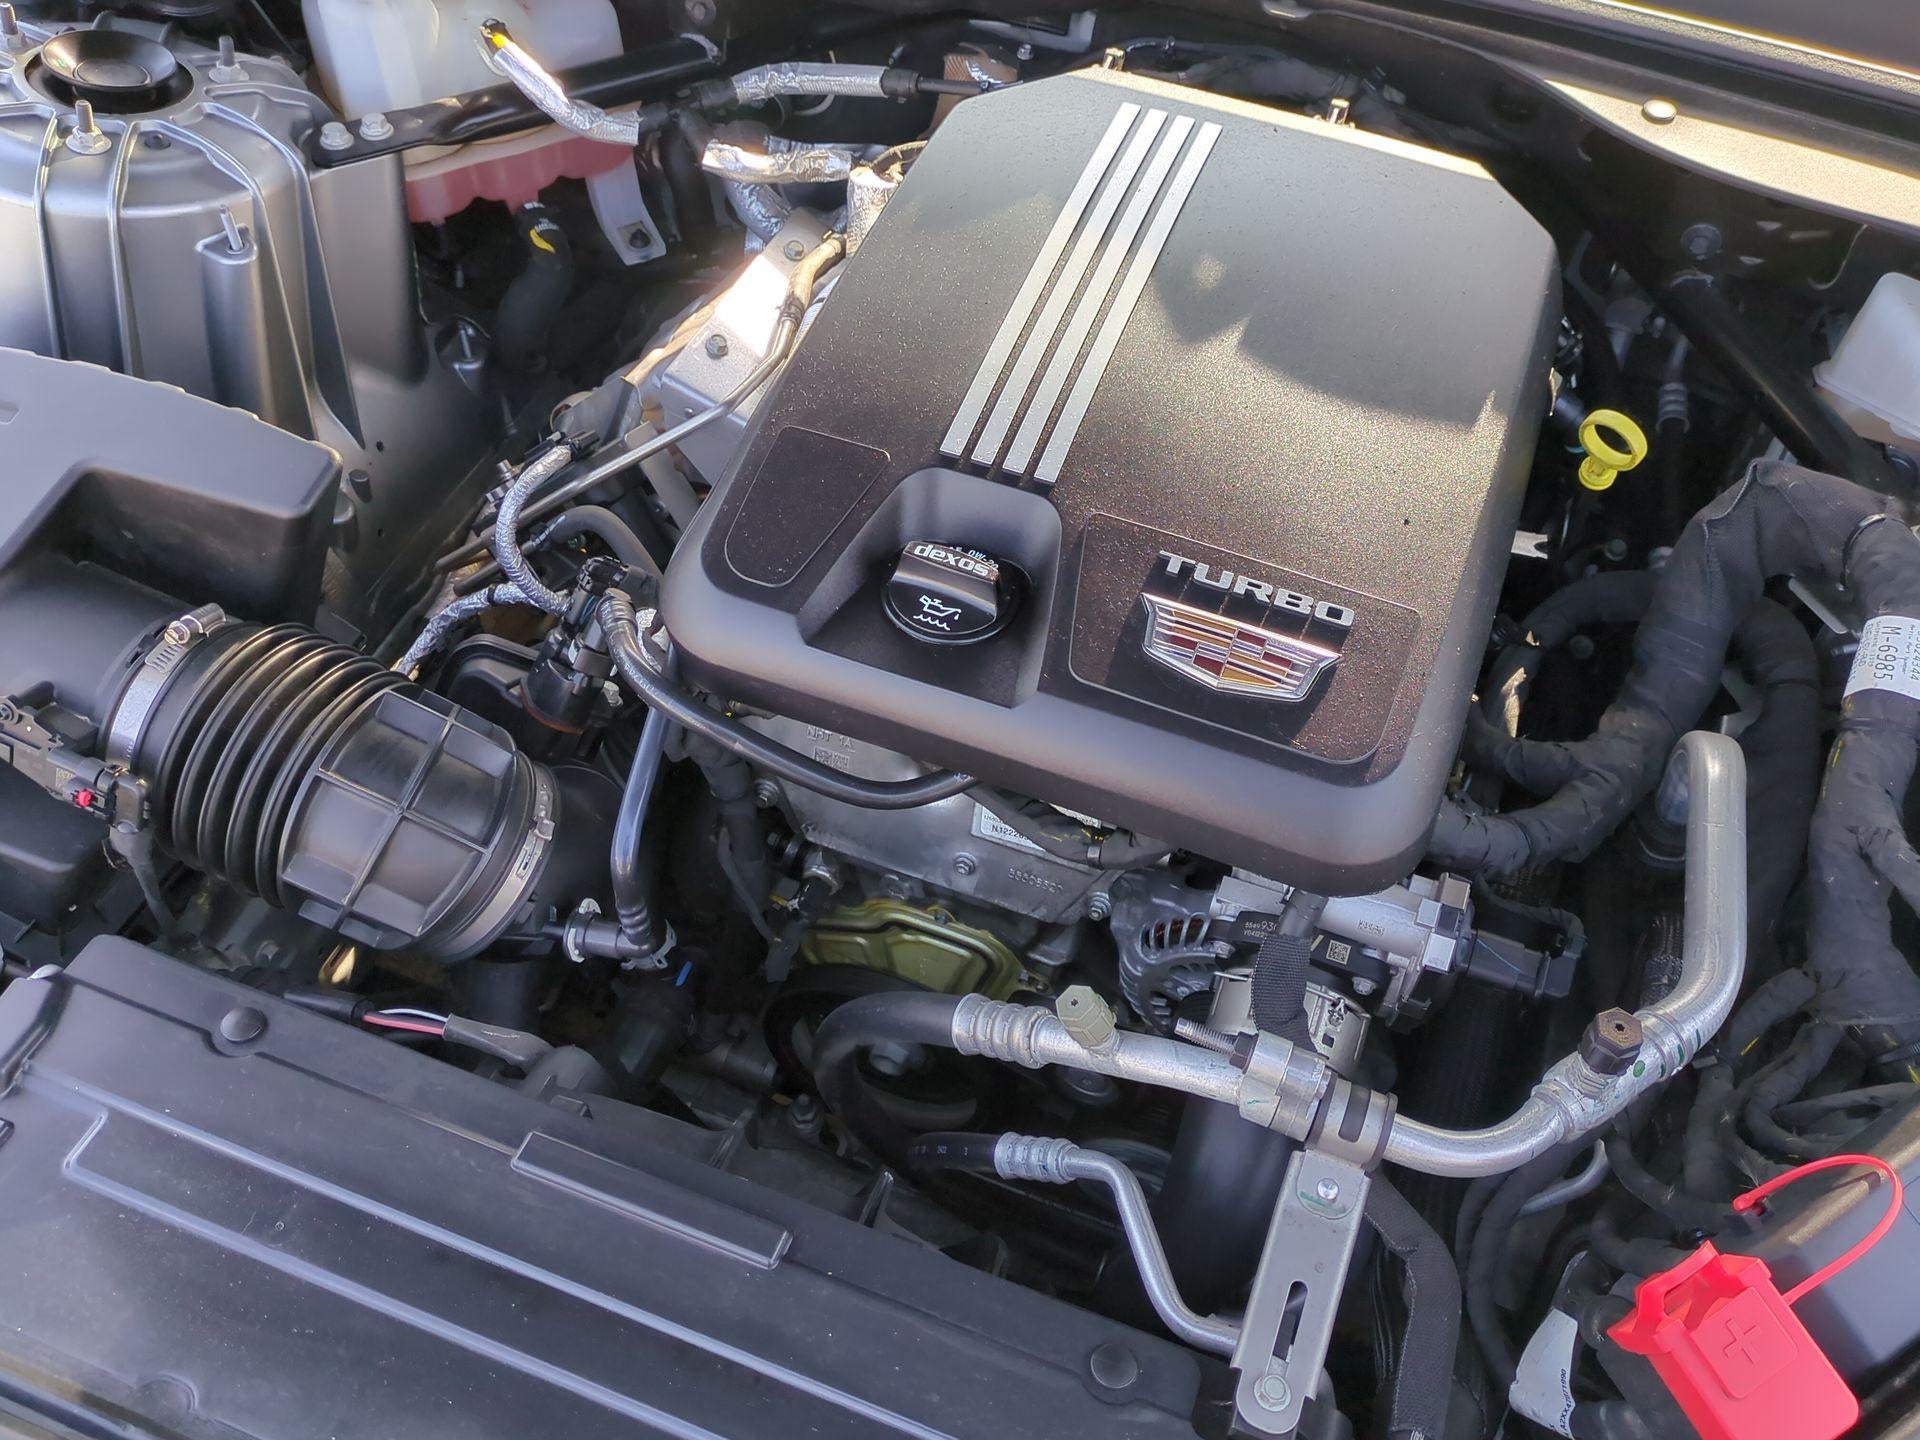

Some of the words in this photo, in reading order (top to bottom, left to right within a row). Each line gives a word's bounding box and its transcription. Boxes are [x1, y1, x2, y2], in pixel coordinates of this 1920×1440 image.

[913, 544, 989, 577] dexos
[1158, 550, 1355, 627] TURBO
[1873, 625, 1902, 681] M-6985
